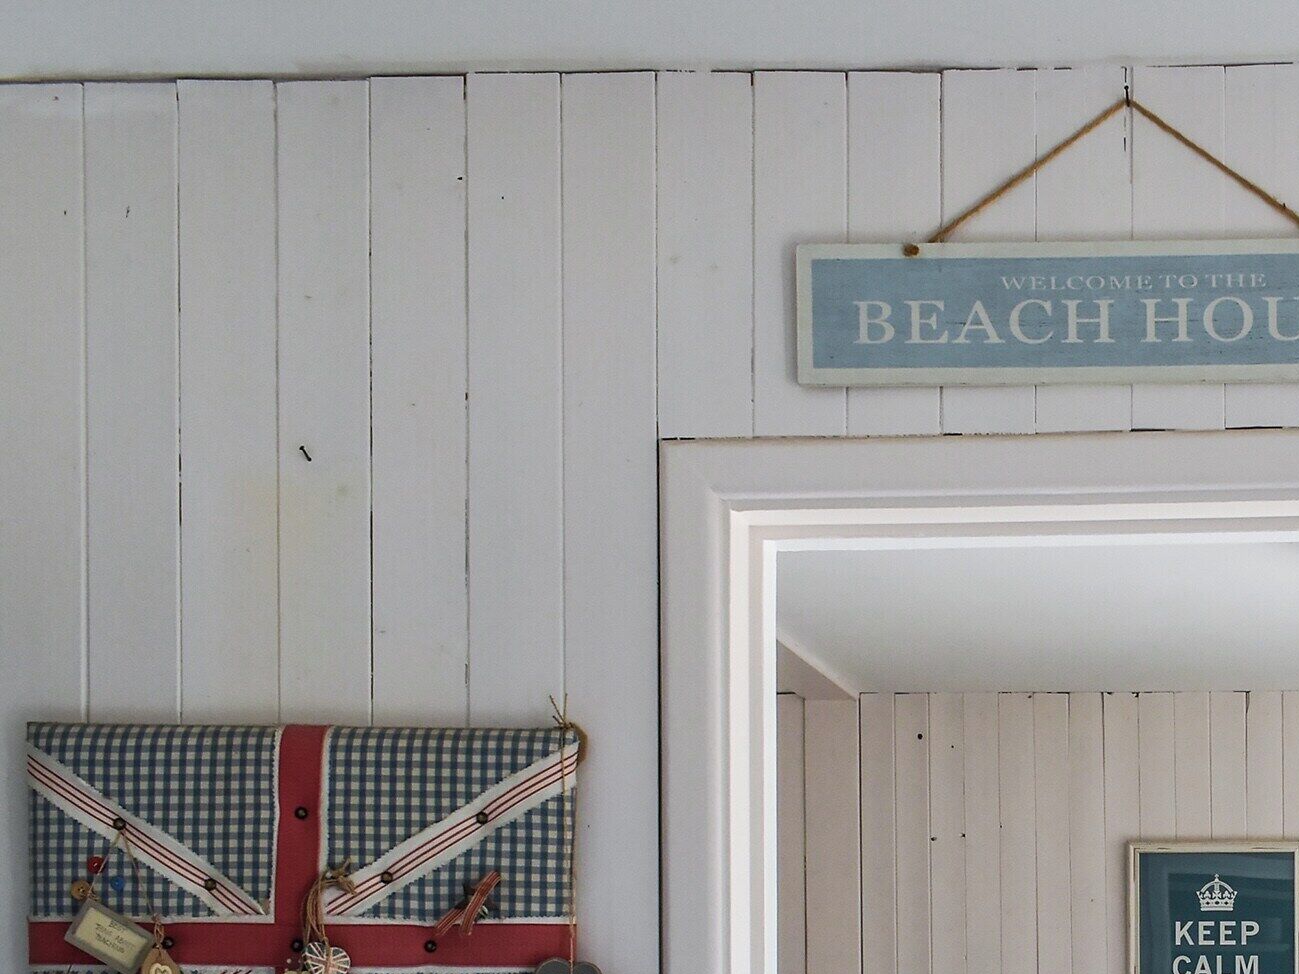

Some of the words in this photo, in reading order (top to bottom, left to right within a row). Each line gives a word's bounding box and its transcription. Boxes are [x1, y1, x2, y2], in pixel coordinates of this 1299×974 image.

[1001, 275, 1153, 291] WELCOME
[1158, 274, 1199, 289] TO
[1204, 273, 1267, 288] THE
[852, 298, 1115, 345] BEACH
[1174, 919, 1260, 946] KEEP
